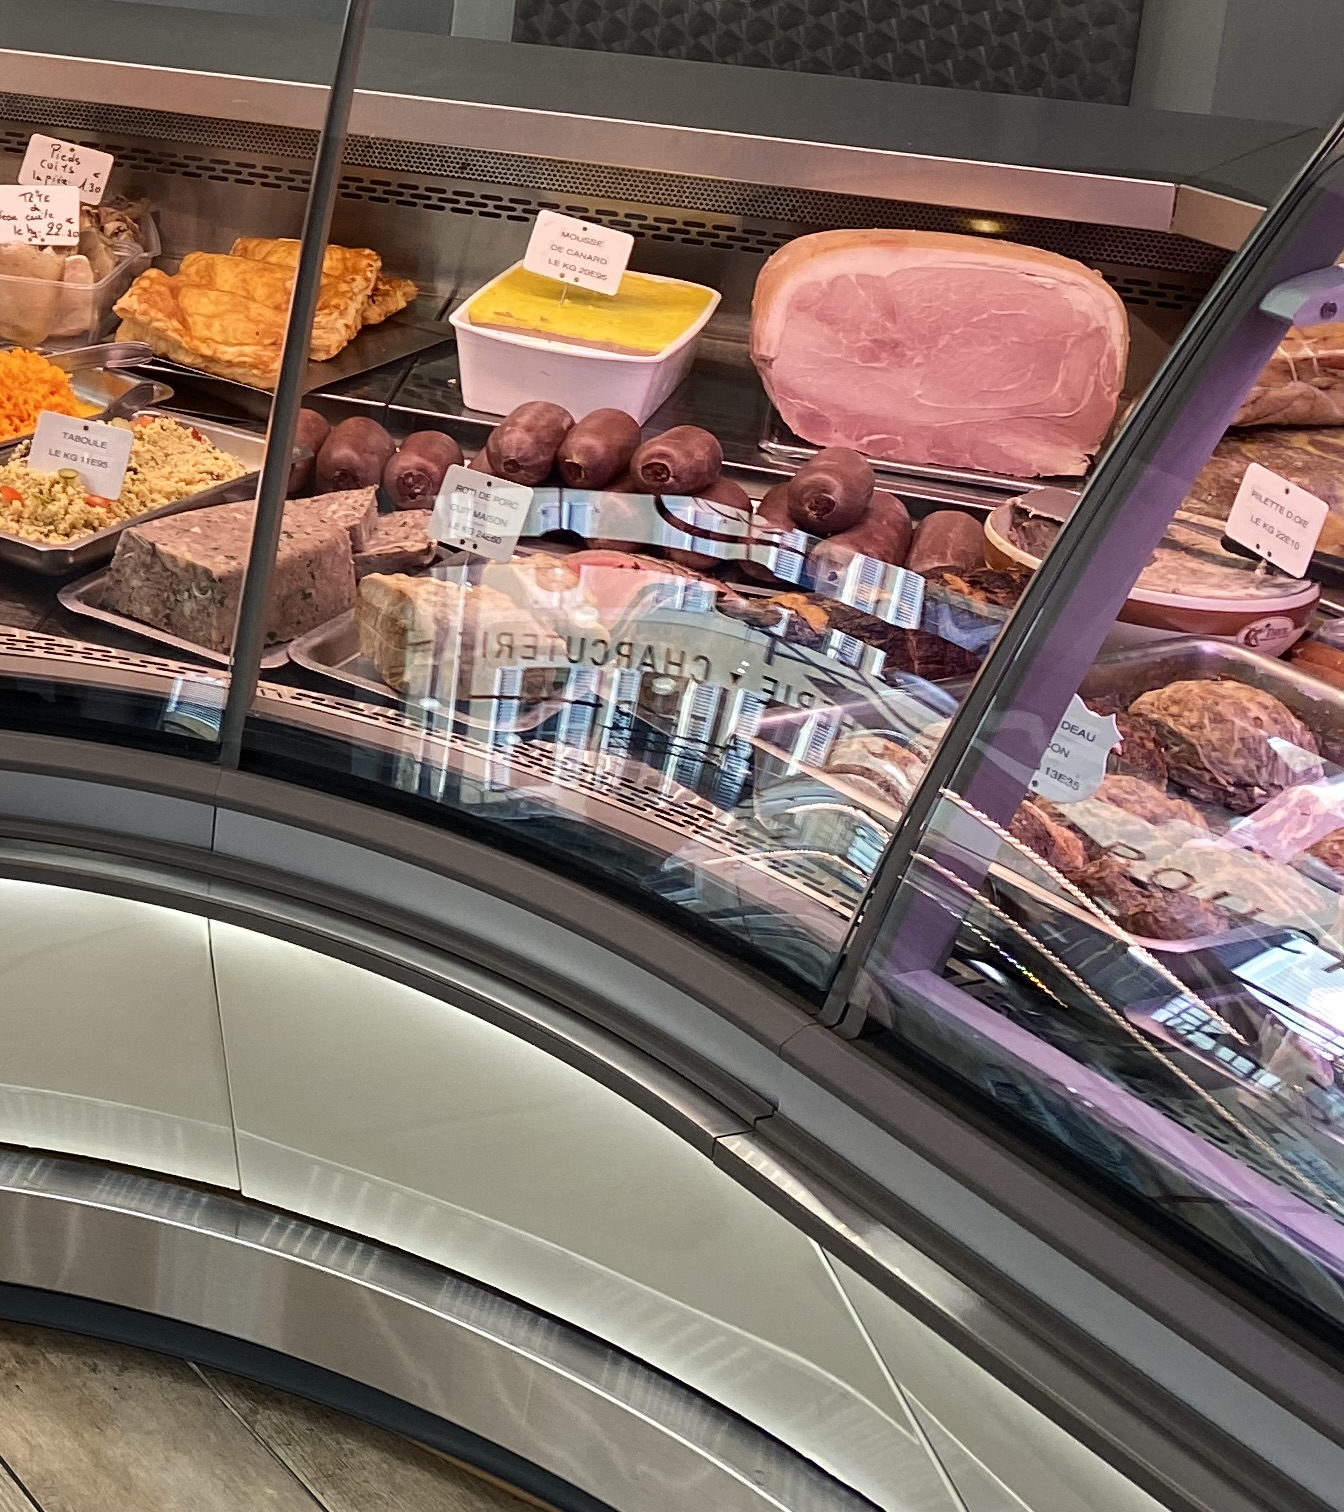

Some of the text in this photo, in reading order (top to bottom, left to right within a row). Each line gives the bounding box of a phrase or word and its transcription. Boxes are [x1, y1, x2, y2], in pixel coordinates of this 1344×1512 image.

[561, 231, 604, 247] MOUSSE
[550, 243, 608, 266] DE CANARD
[548, 258, 561, 267] LE
[562, 262, 576, 272] KG
[62, 431, 107, 449] TABOULE
[48, 448, 60, 458] LE
[63, 451, 78, 462] KG
[478, 491, 491, 502] DE
[493, 496, 519, 510] PORC
[473, 511, 508, 527] MAISON
[1250, 514, 1261, 526] LE
[1262, 523, 1275, 535] KG
[1045, 767, 1080, 790] 13E35
